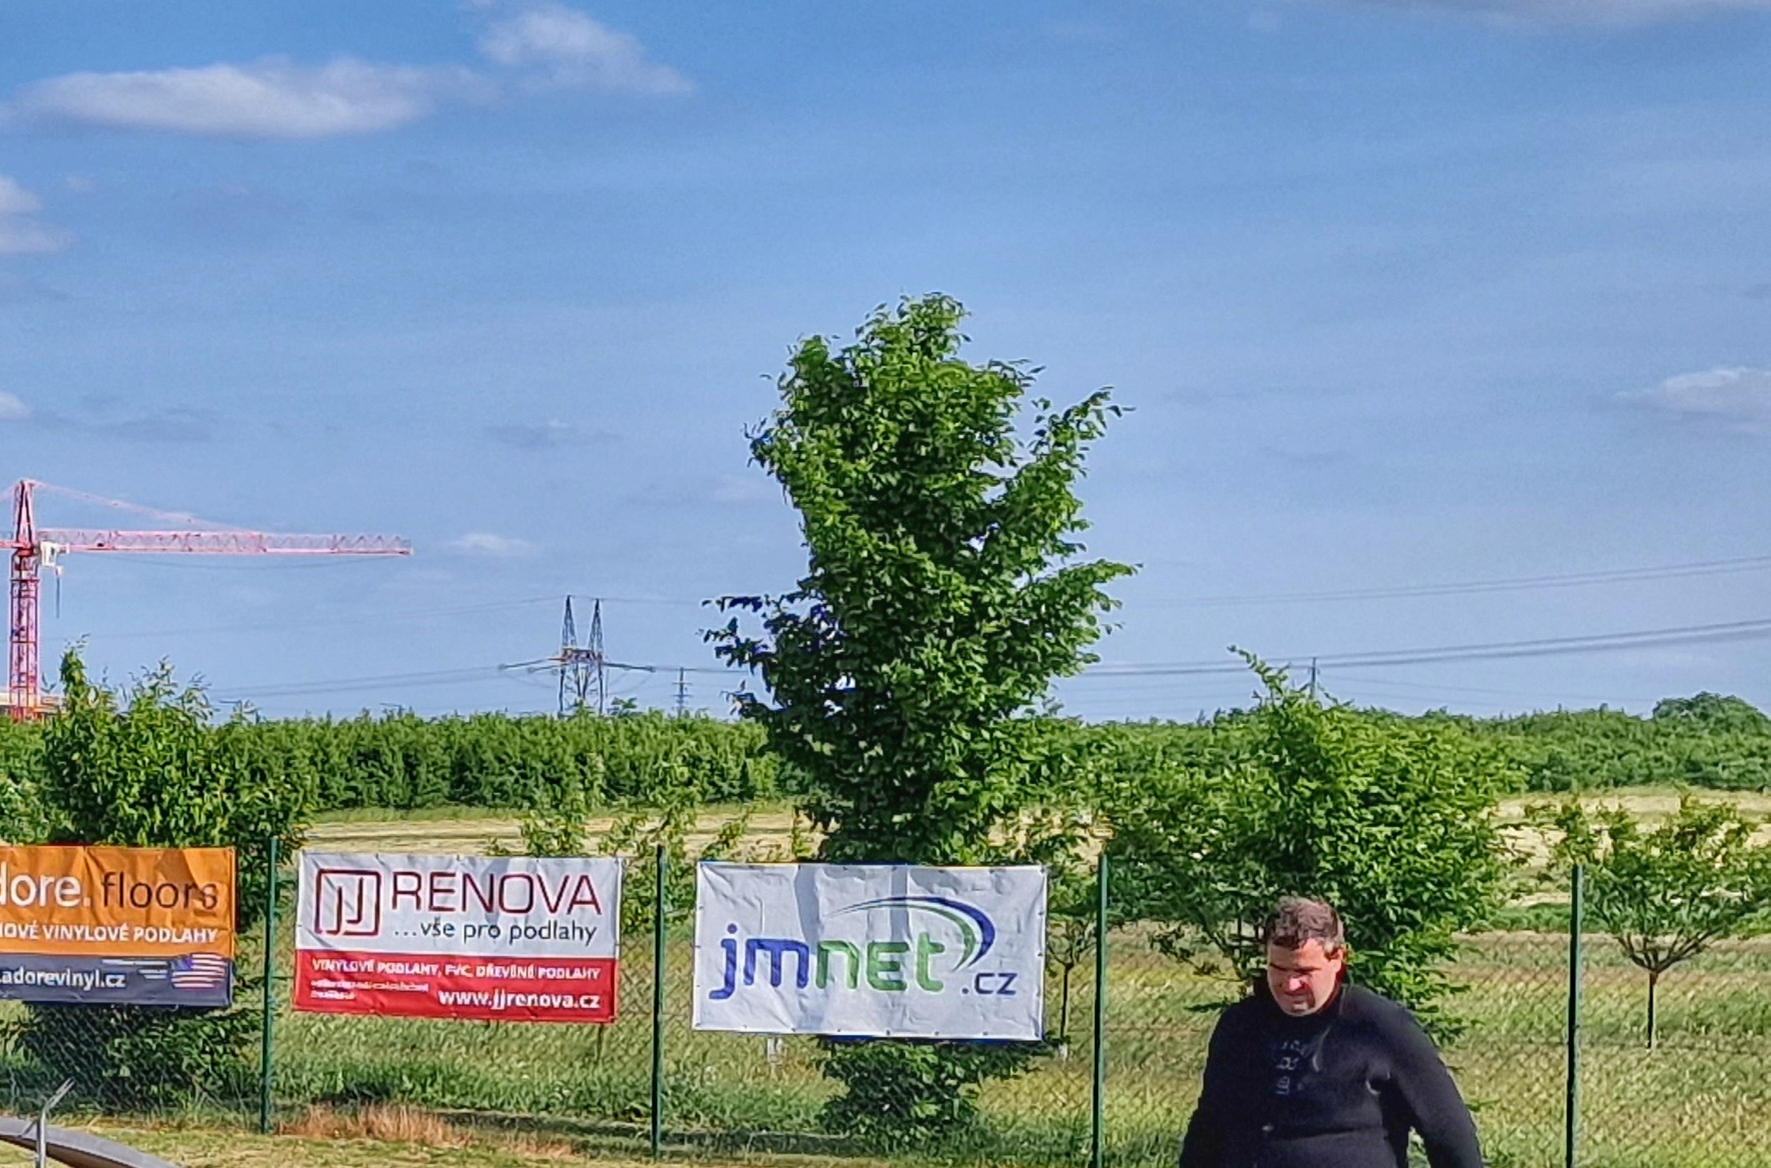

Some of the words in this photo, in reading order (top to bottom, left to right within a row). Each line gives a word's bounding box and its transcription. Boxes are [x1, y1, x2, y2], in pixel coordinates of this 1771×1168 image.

[101, 871, 219, 910] floors
[391, 871, 602, 915] RENOVA
[42, 922, 129, 942] VINYLOVÉ
[133, 927, 219, 944] PODLAHY
[463, 925, 501, 944] pro
[509, 920, 598, 947] podlahy
[538, 966, 601, 981] PODLAHY
[437, 988, 601, 1011] www.jjrenova.cz
